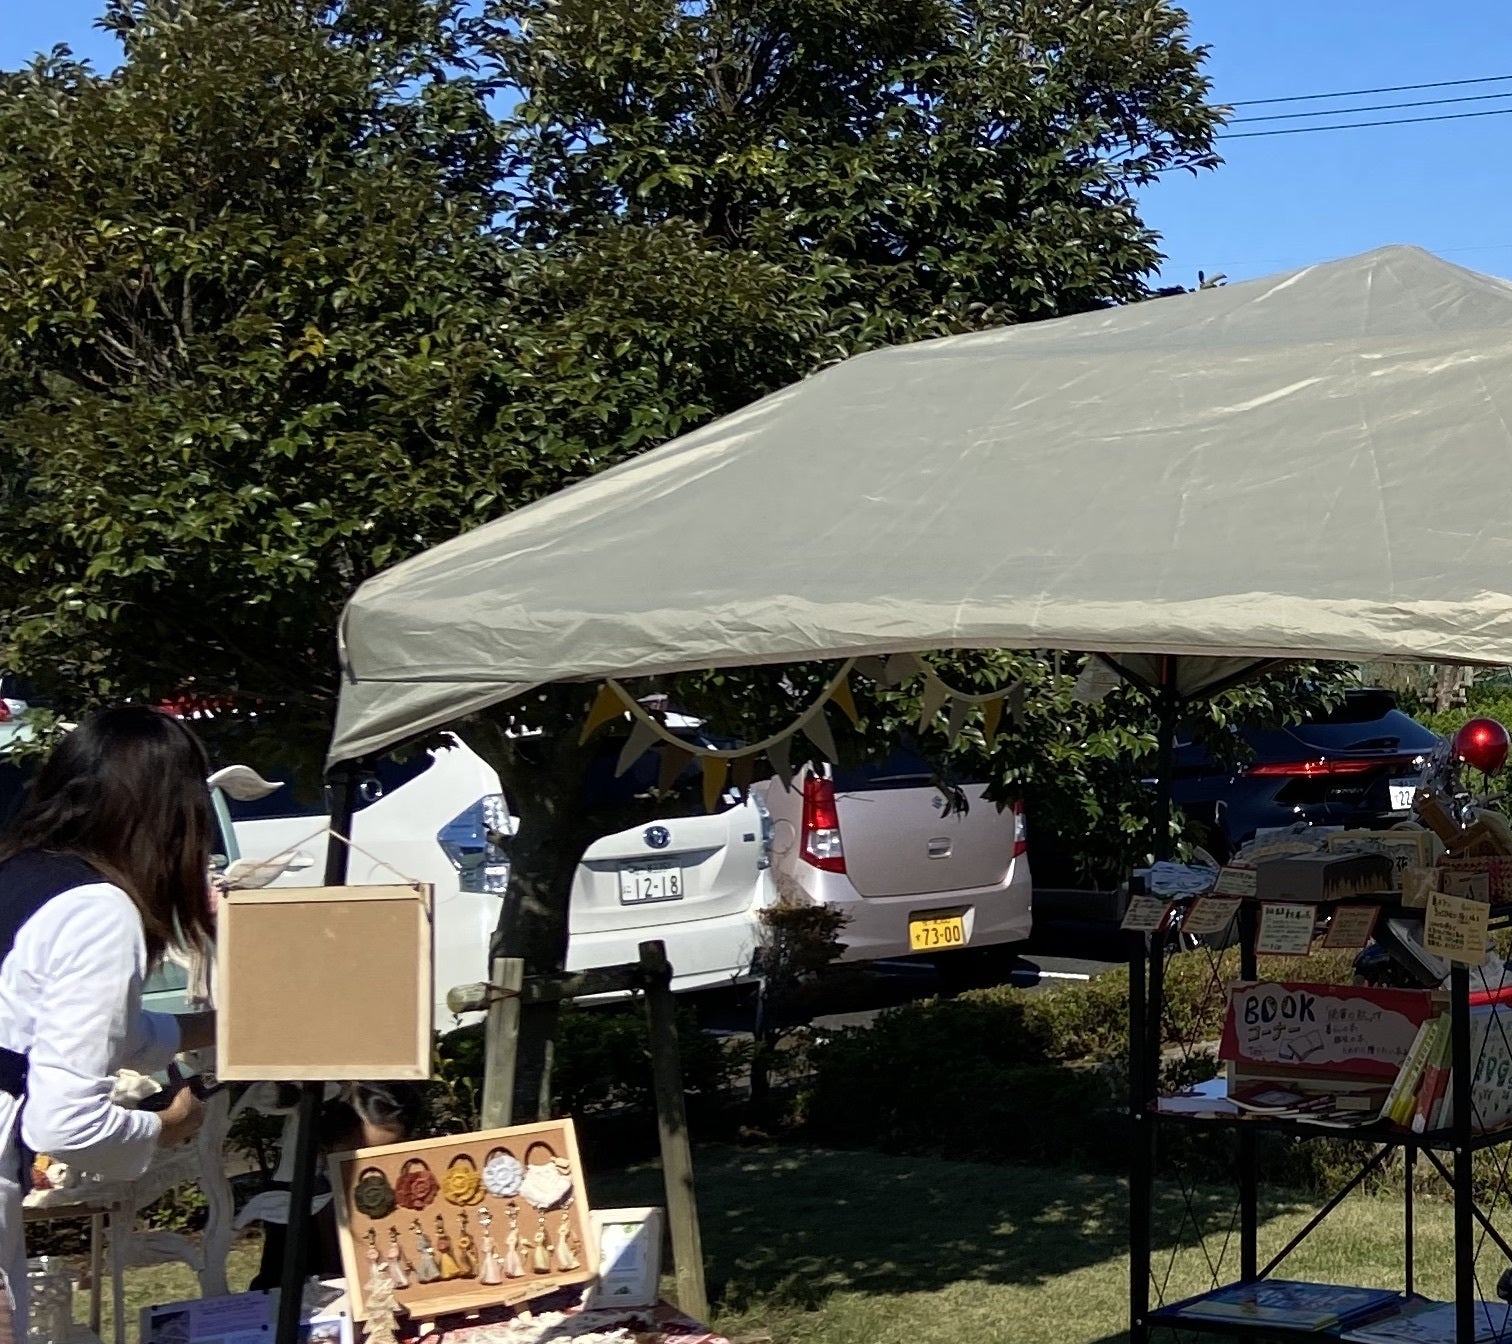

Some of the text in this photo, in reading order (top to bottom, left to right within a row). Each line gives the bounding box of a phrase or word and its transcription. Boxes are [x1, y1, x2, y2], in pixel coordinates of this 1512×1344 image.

[635, 874, 679, 900] 12-18
[922, 925, 961, 946] 73-00
[1244, 993, 1316, 1025] BOOK
[1247, 1022, 1301, 1043] コーナー
